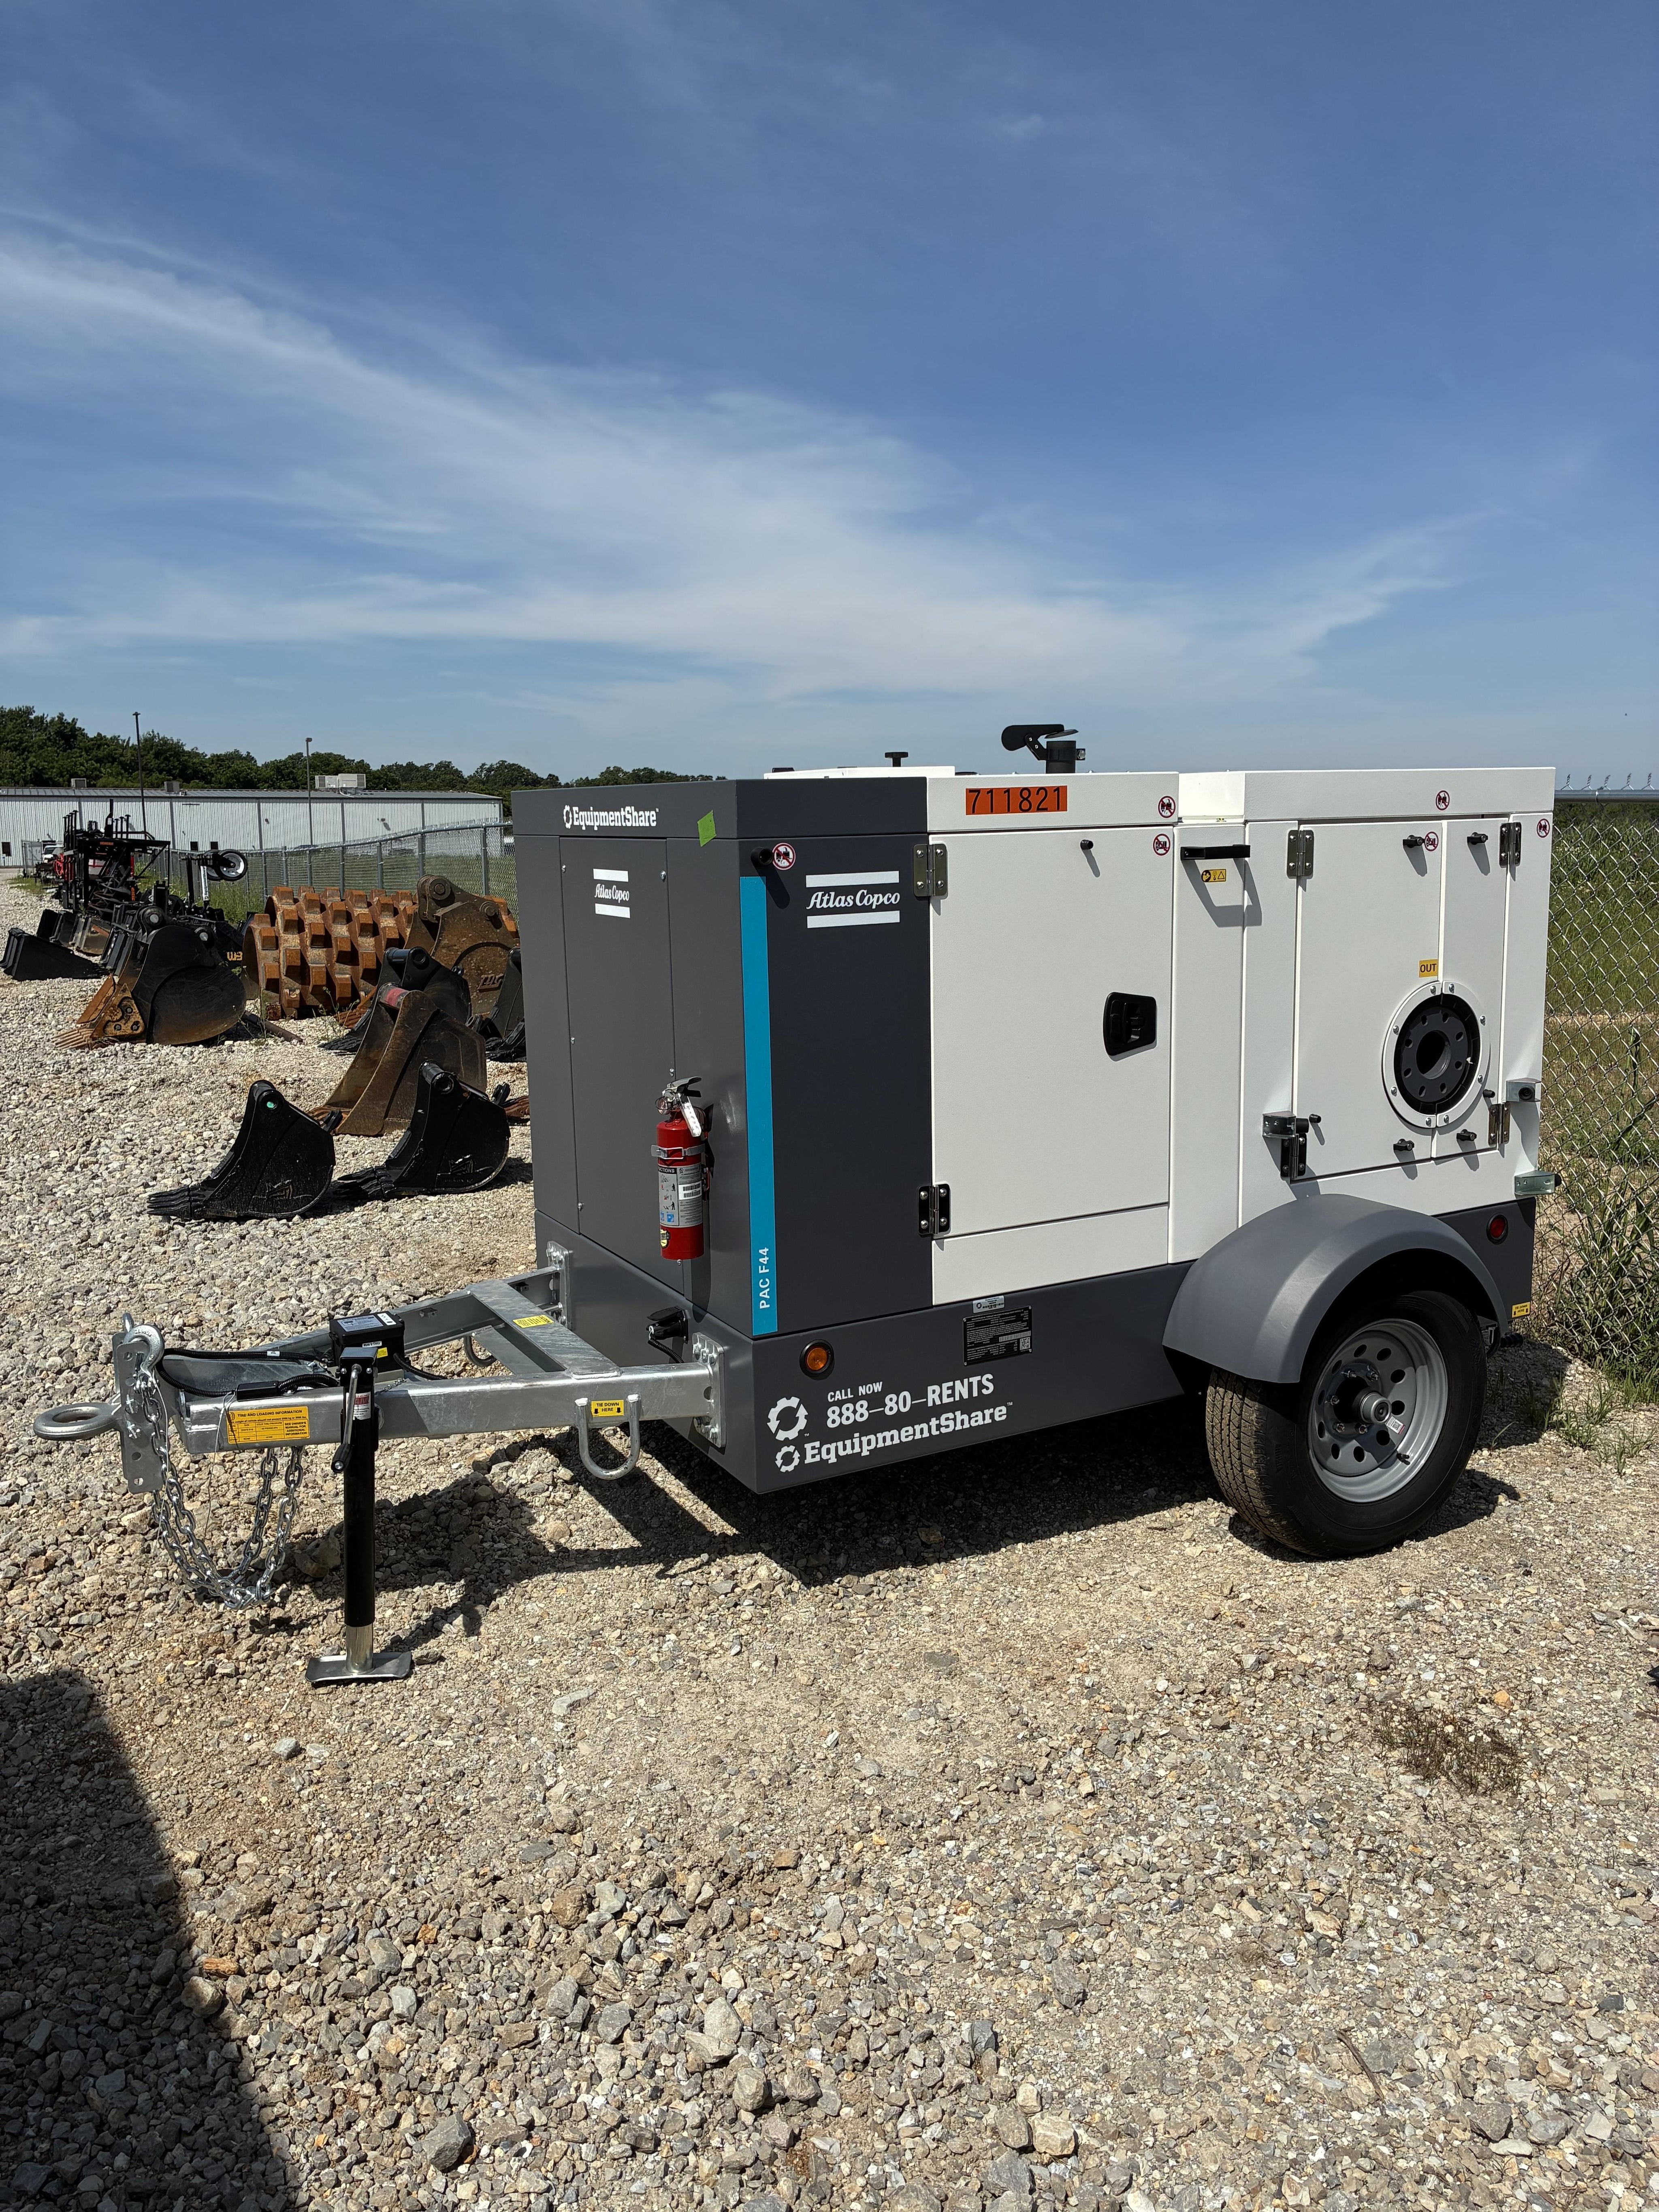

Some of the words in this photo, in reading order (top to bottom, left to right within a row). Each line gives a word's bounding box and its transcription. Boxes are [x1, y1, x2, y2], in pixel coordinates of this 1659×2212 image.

[968, 787, 1060, 814] 711821
[572, 806, 657, 830] EquipmentShare
[594, 883, 612, 899] Atlas
[612, 885, 629, 903] Copco
[806, 891, 854, 909] Atlas
[855, 889, 900, 909] Copco
[1420, 963, 1437, 973] OUT
[759, 1247, 770, 1273] F44
[759, 1278, 770, 1309] PAC
[827, 1387, 853, 1402] CALL
[858, 1381, 883, 1395] NOW
[804, 1406, 1007, 1464] EquipmentShare
